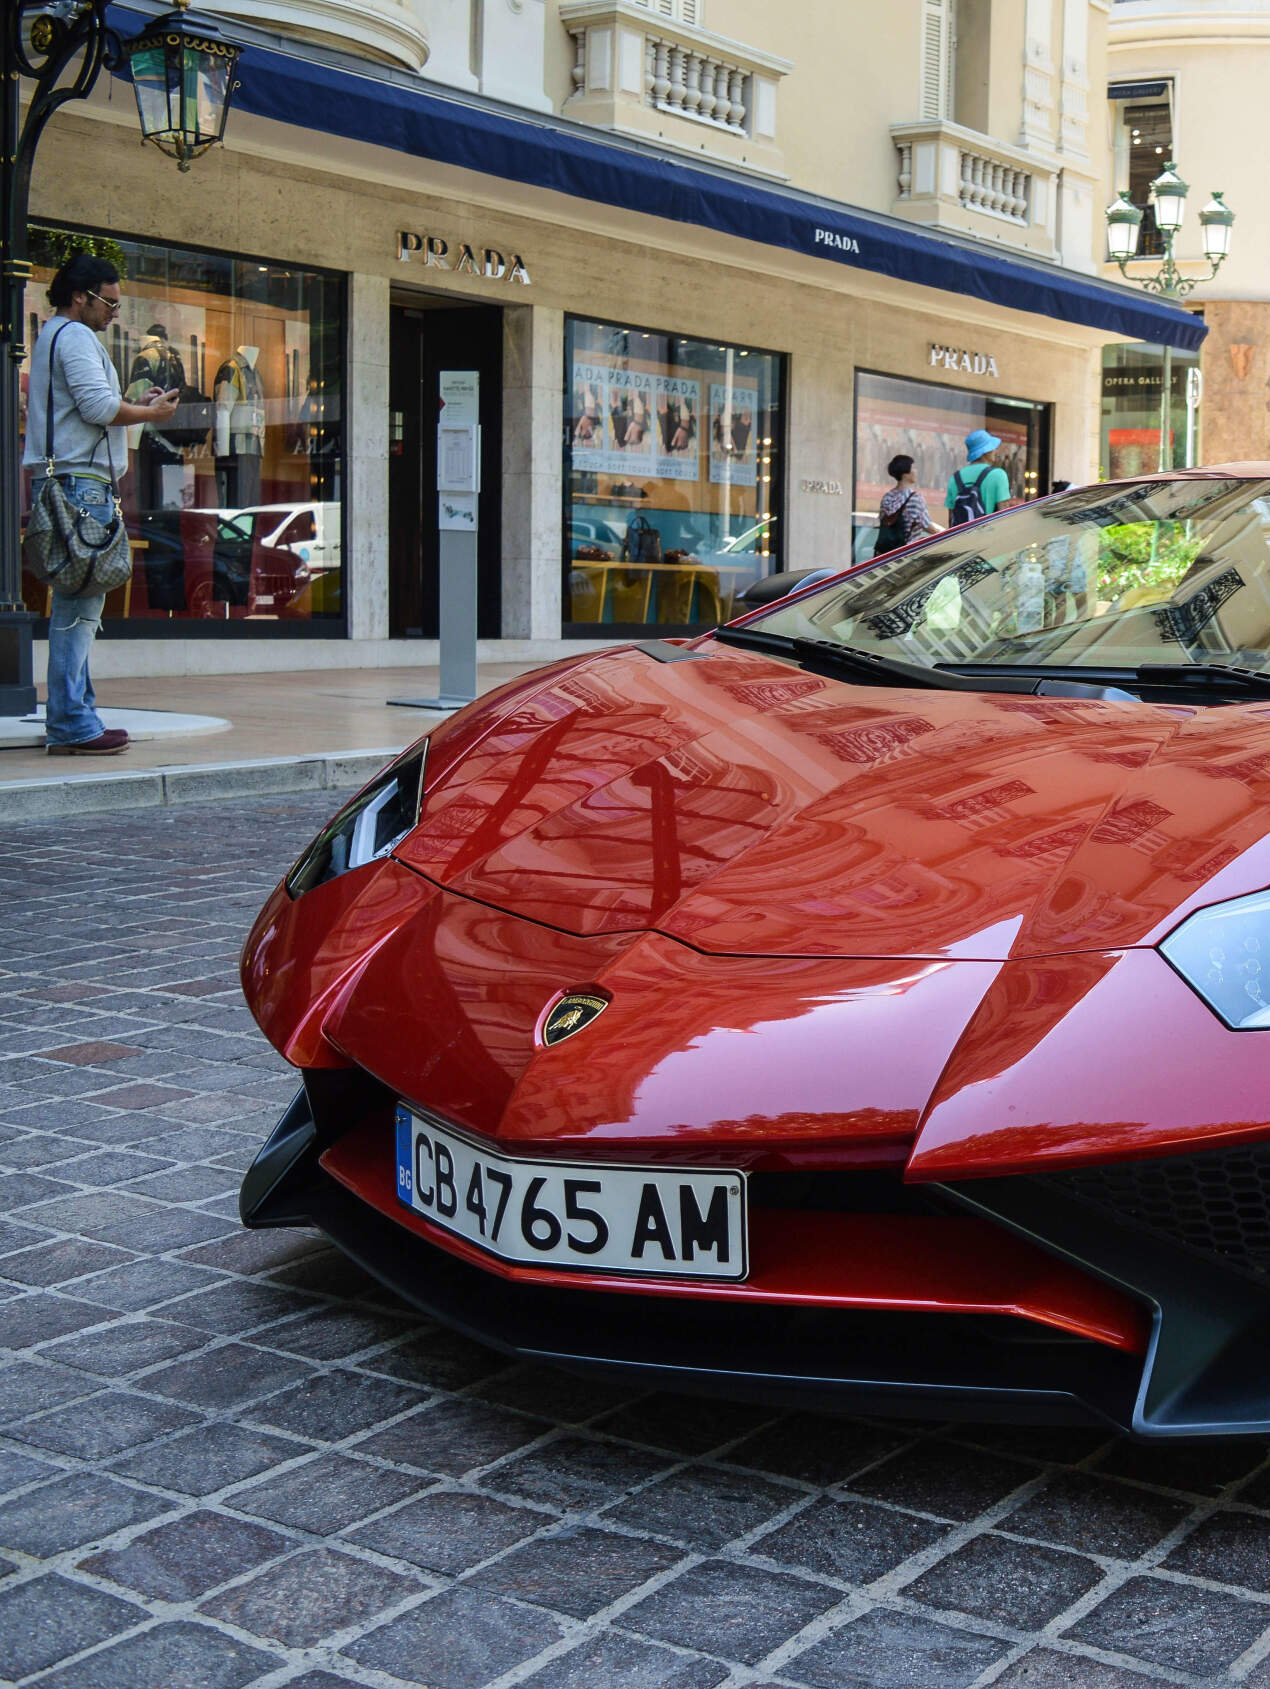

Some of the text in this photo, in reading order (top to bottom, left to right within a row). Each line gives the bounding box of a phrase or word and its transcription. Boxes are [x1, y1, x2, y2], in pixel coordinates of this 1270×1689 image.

[815, 229, 860, 254] PRADA
[397, 231, 532, 285] PRADA
[928, 343, 999, 377] PRADA
[608, 369, 650, 389] PRADA
[656, 378, 698, 396] PRADA
[1105, 376, 1178, 386] OPERA GALLY
[399, 1165, 412, 1190] BG
[630, 1183, 730, 1263] AM
